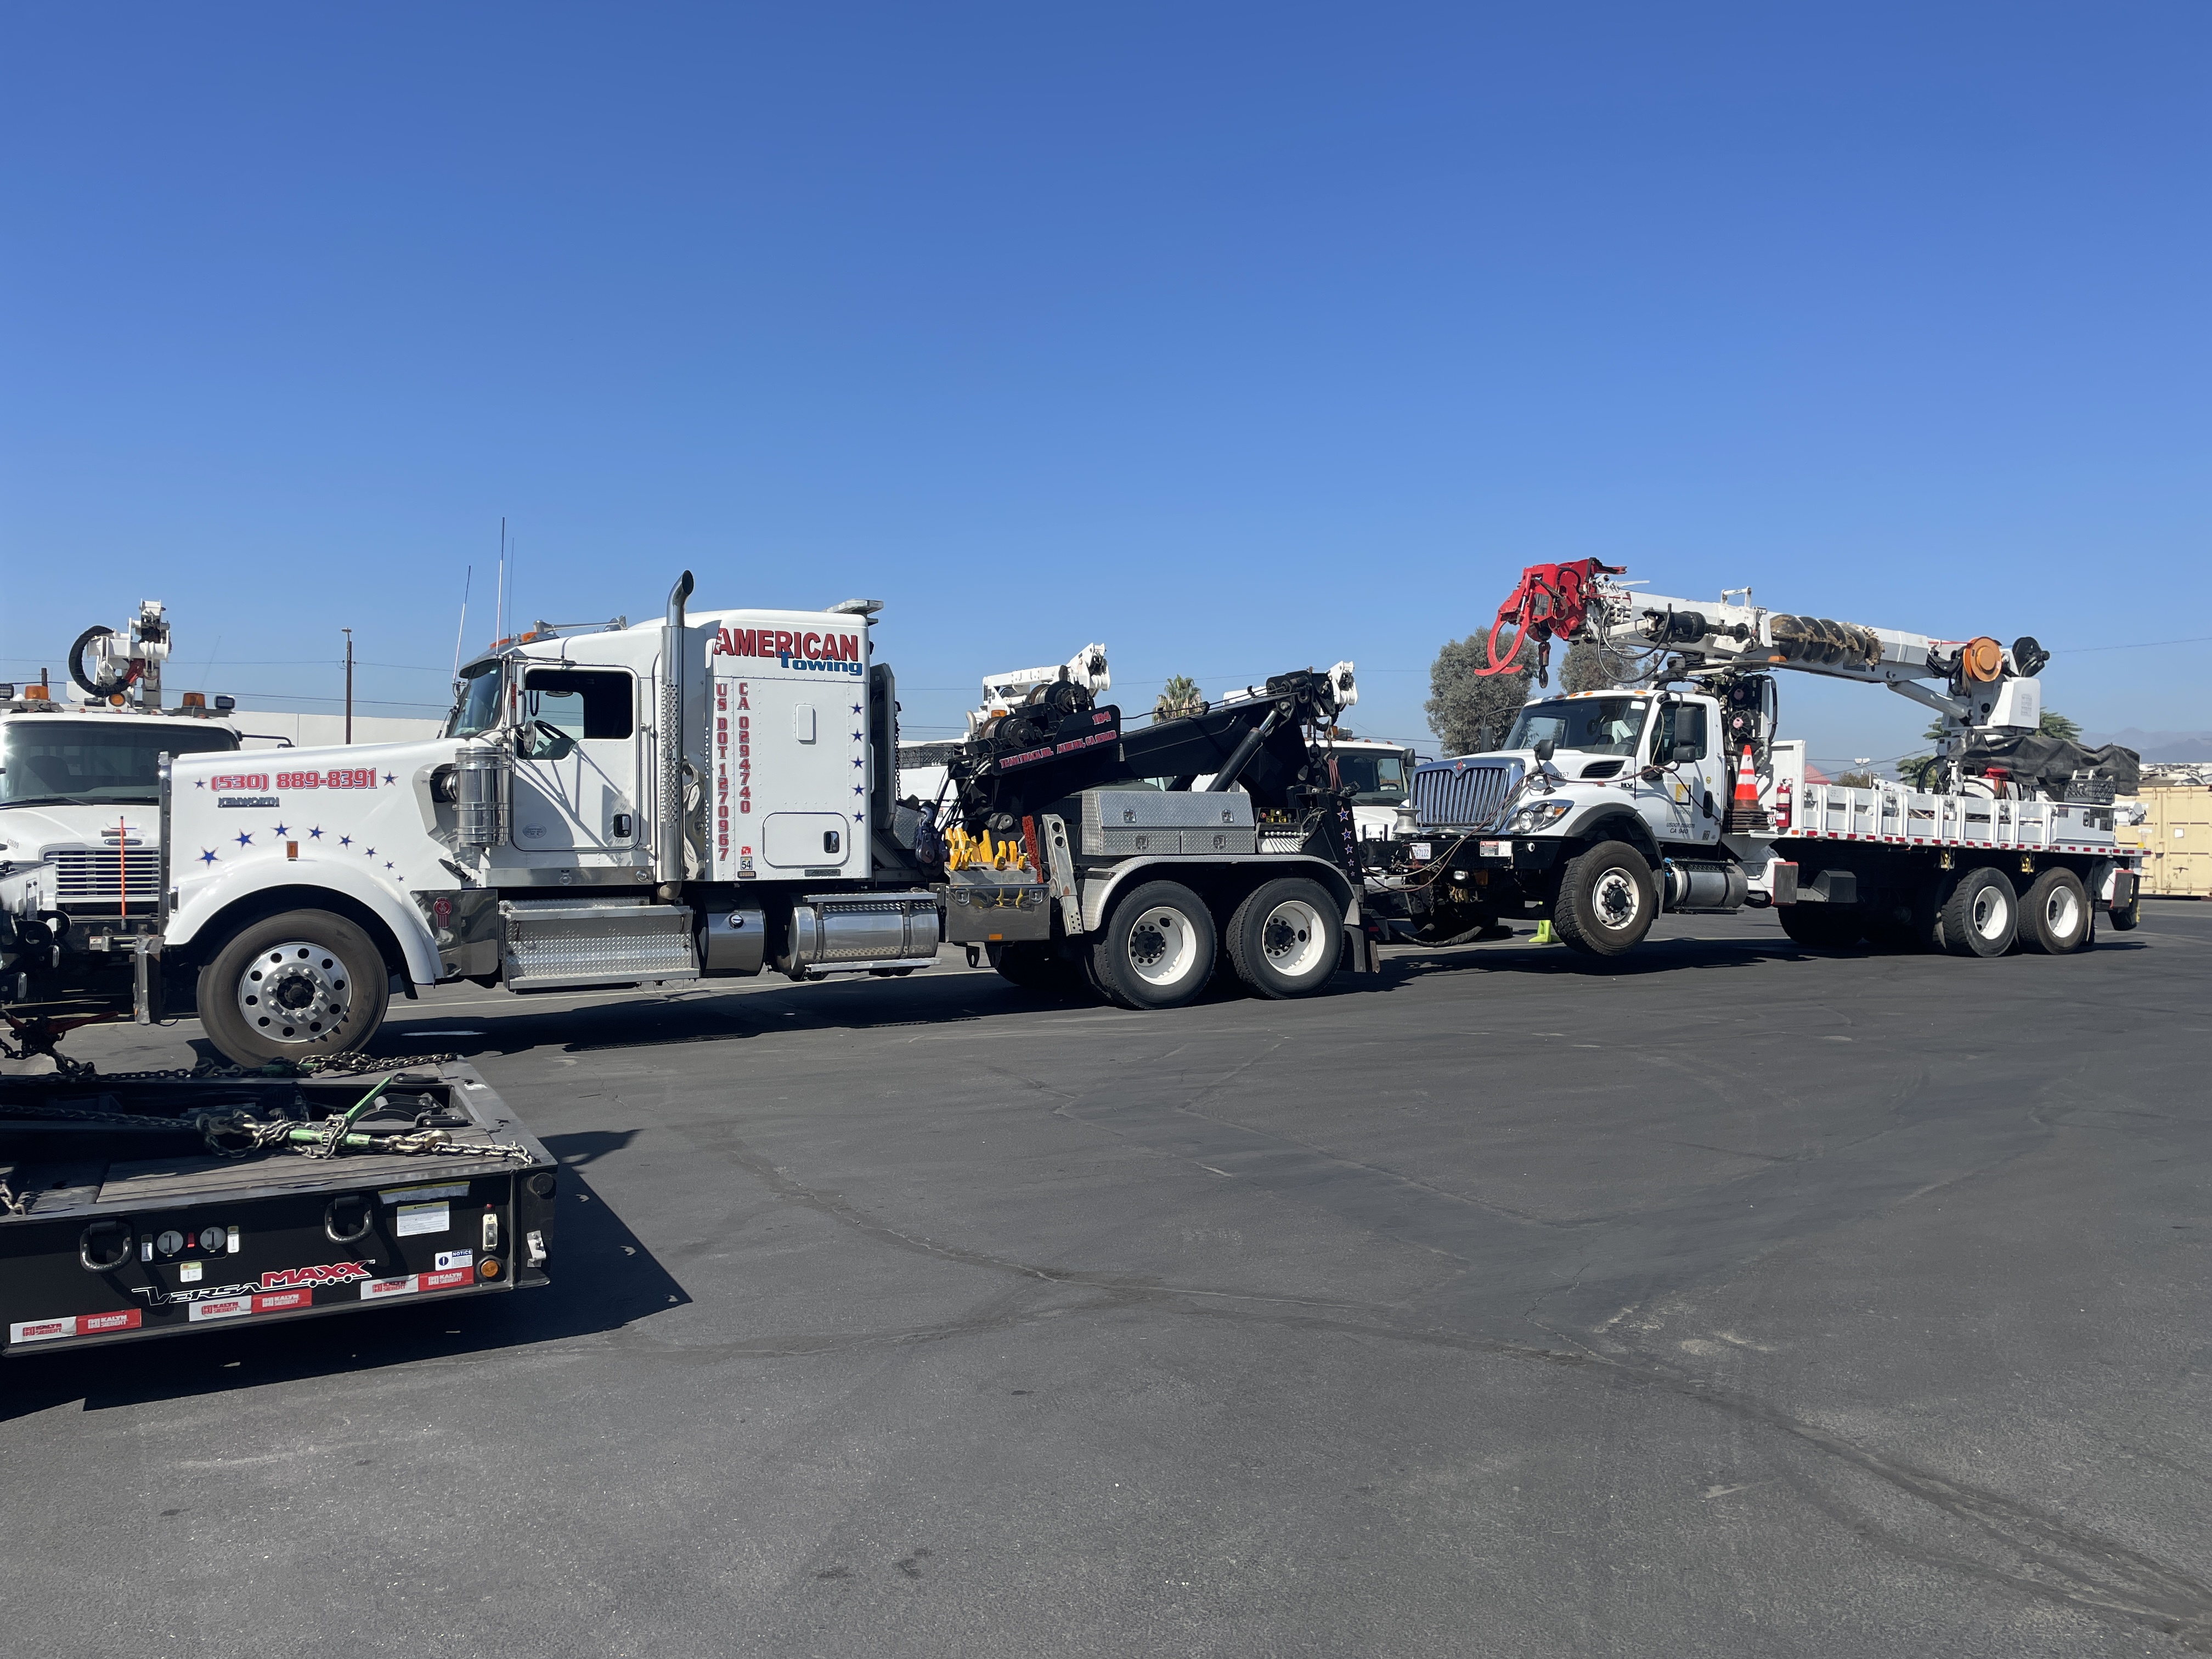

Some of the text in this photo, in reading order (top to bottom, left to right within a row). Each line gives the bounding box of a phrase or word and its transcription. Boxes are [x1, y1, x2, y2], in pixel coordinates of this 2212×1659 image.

[713, 628, 859, 662] AMERICAN
[776, 651, 863, 676] Towing
[737, 682, 751, 814] CA 0294740
[211, 768, 377, 792] (530) 889-8391
[715, 683, 729, 861] US DOT 1270967
[218, 797, 280, 808] KENWORTH
[742, 860, 752, 869] 54
